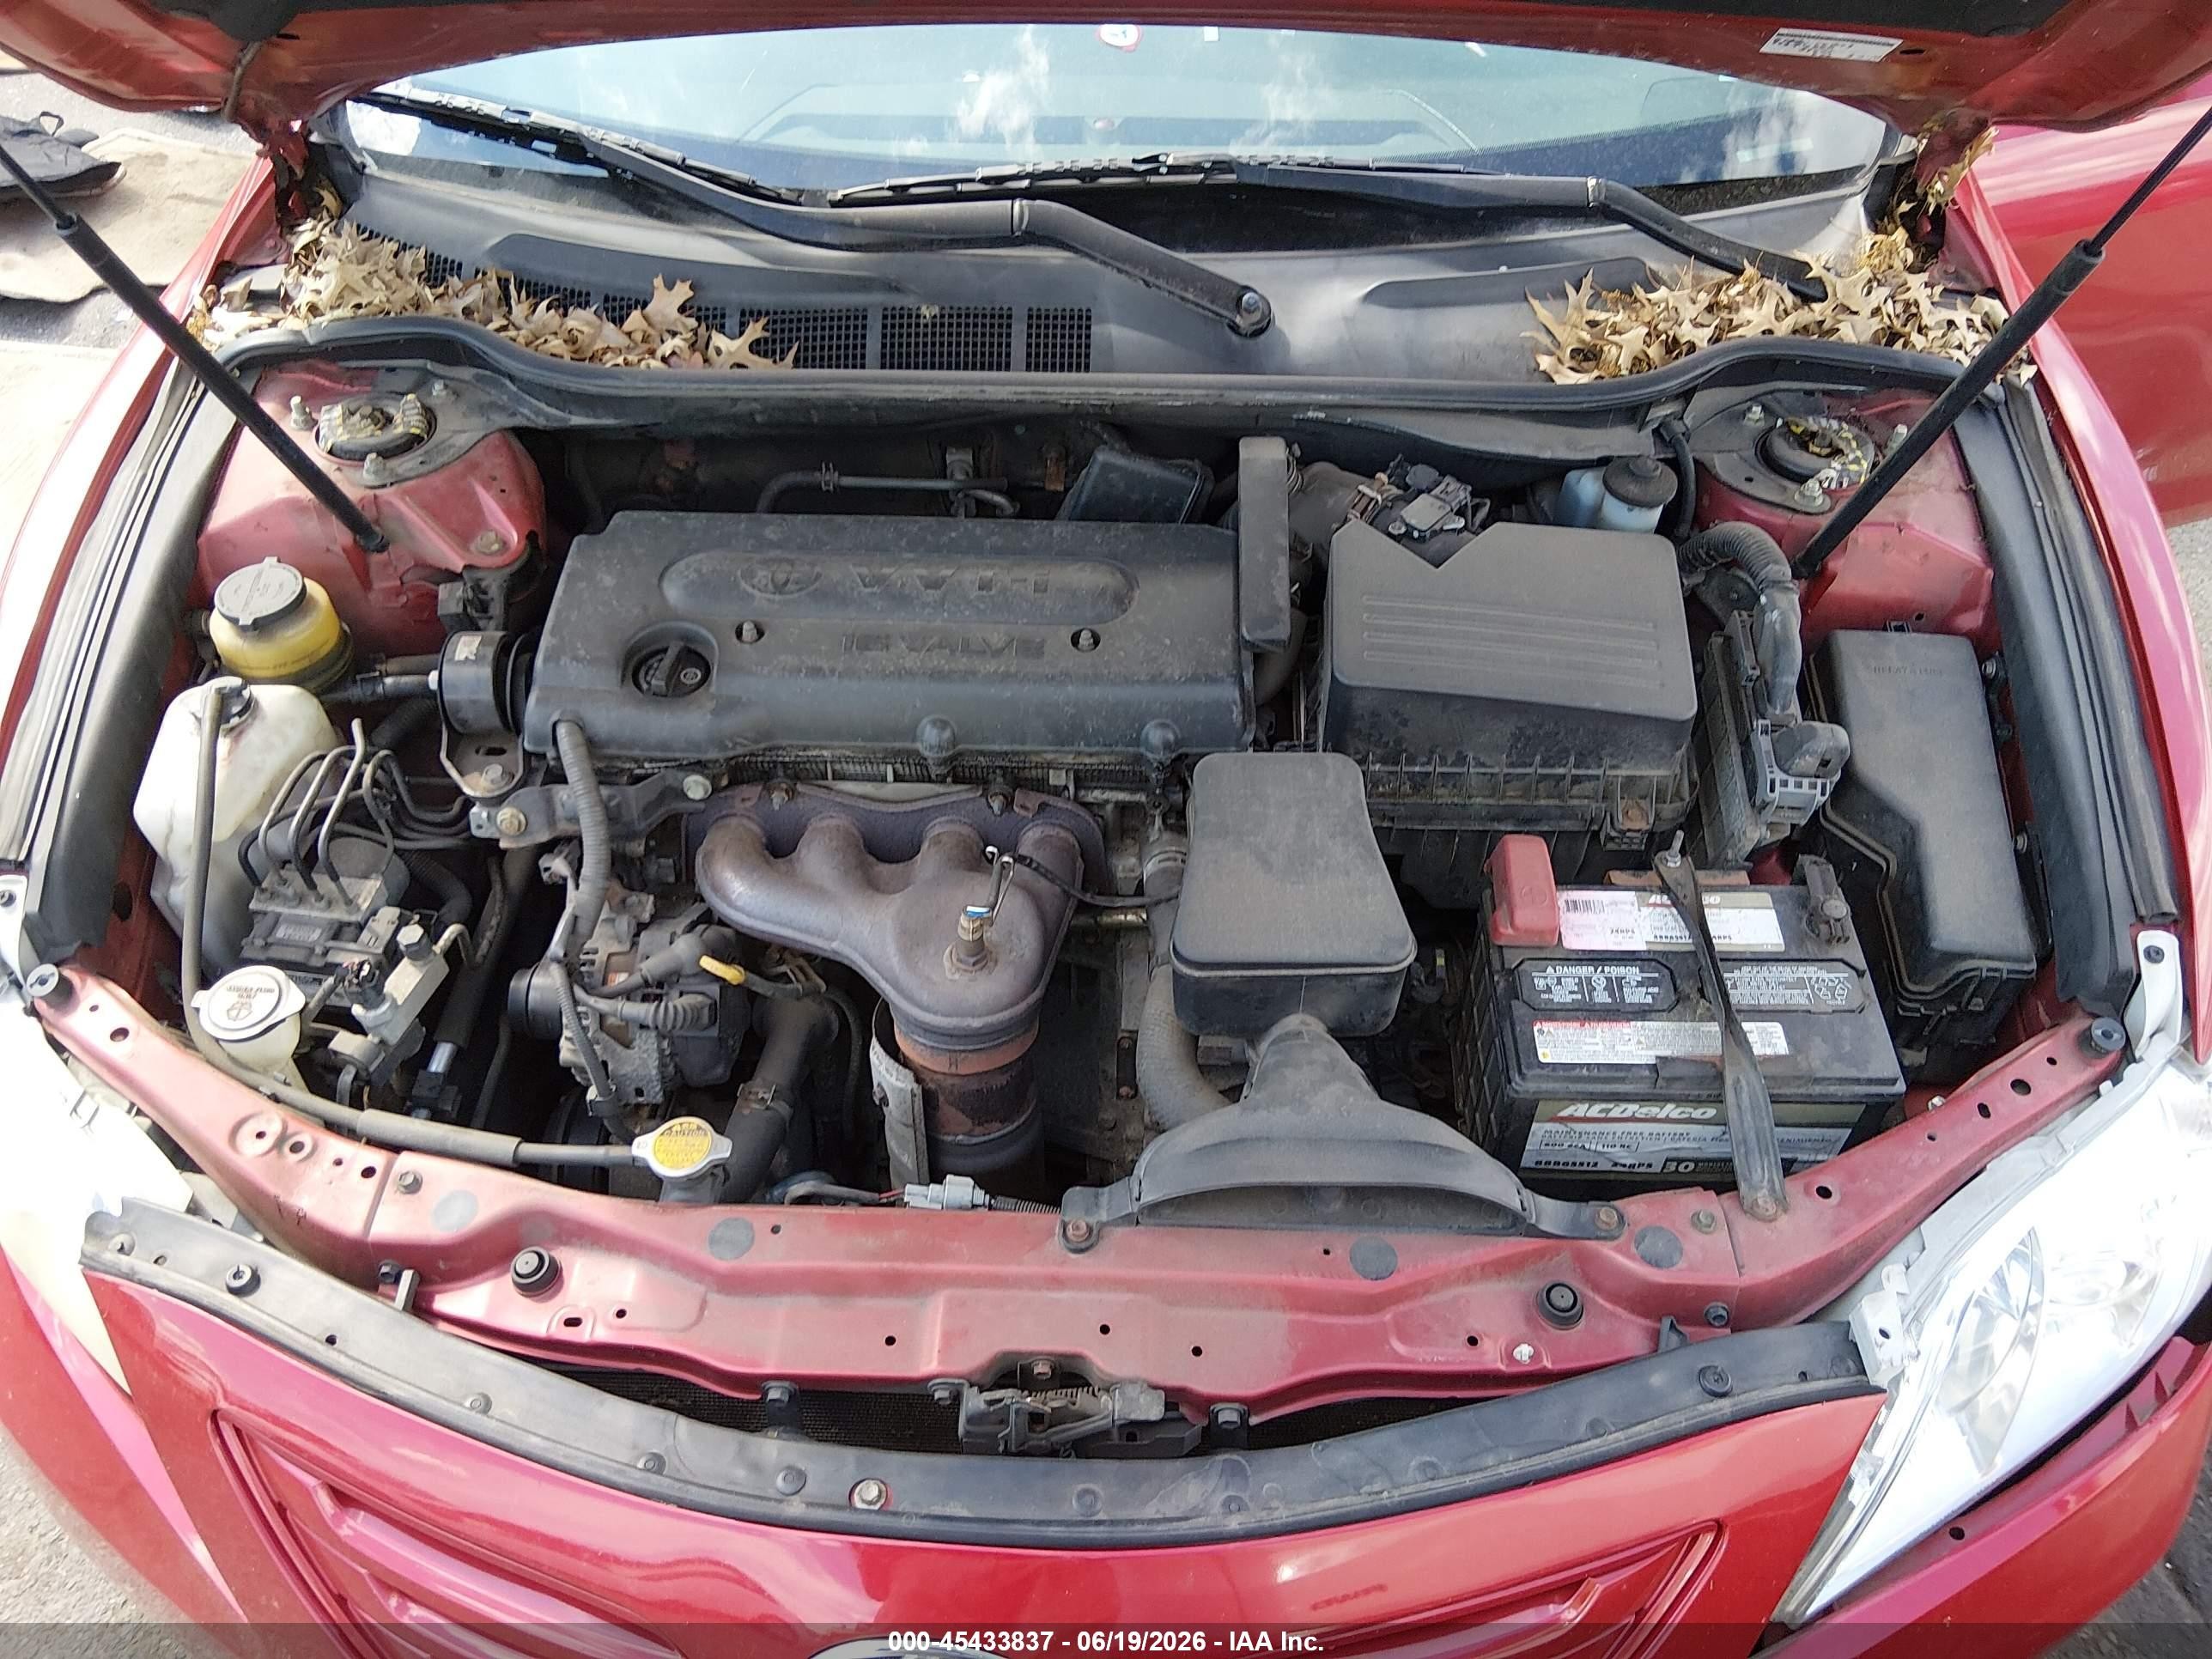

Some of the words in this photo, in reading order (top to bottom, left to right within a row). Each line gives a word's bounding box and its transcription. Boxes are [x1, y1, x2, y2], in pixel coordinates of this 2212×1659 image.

[1555, 965, 1595, 975] DANGER
[1603, 966, 1640, 975] POISON
[1556, 1103, 1718, 1120] ACDelco
